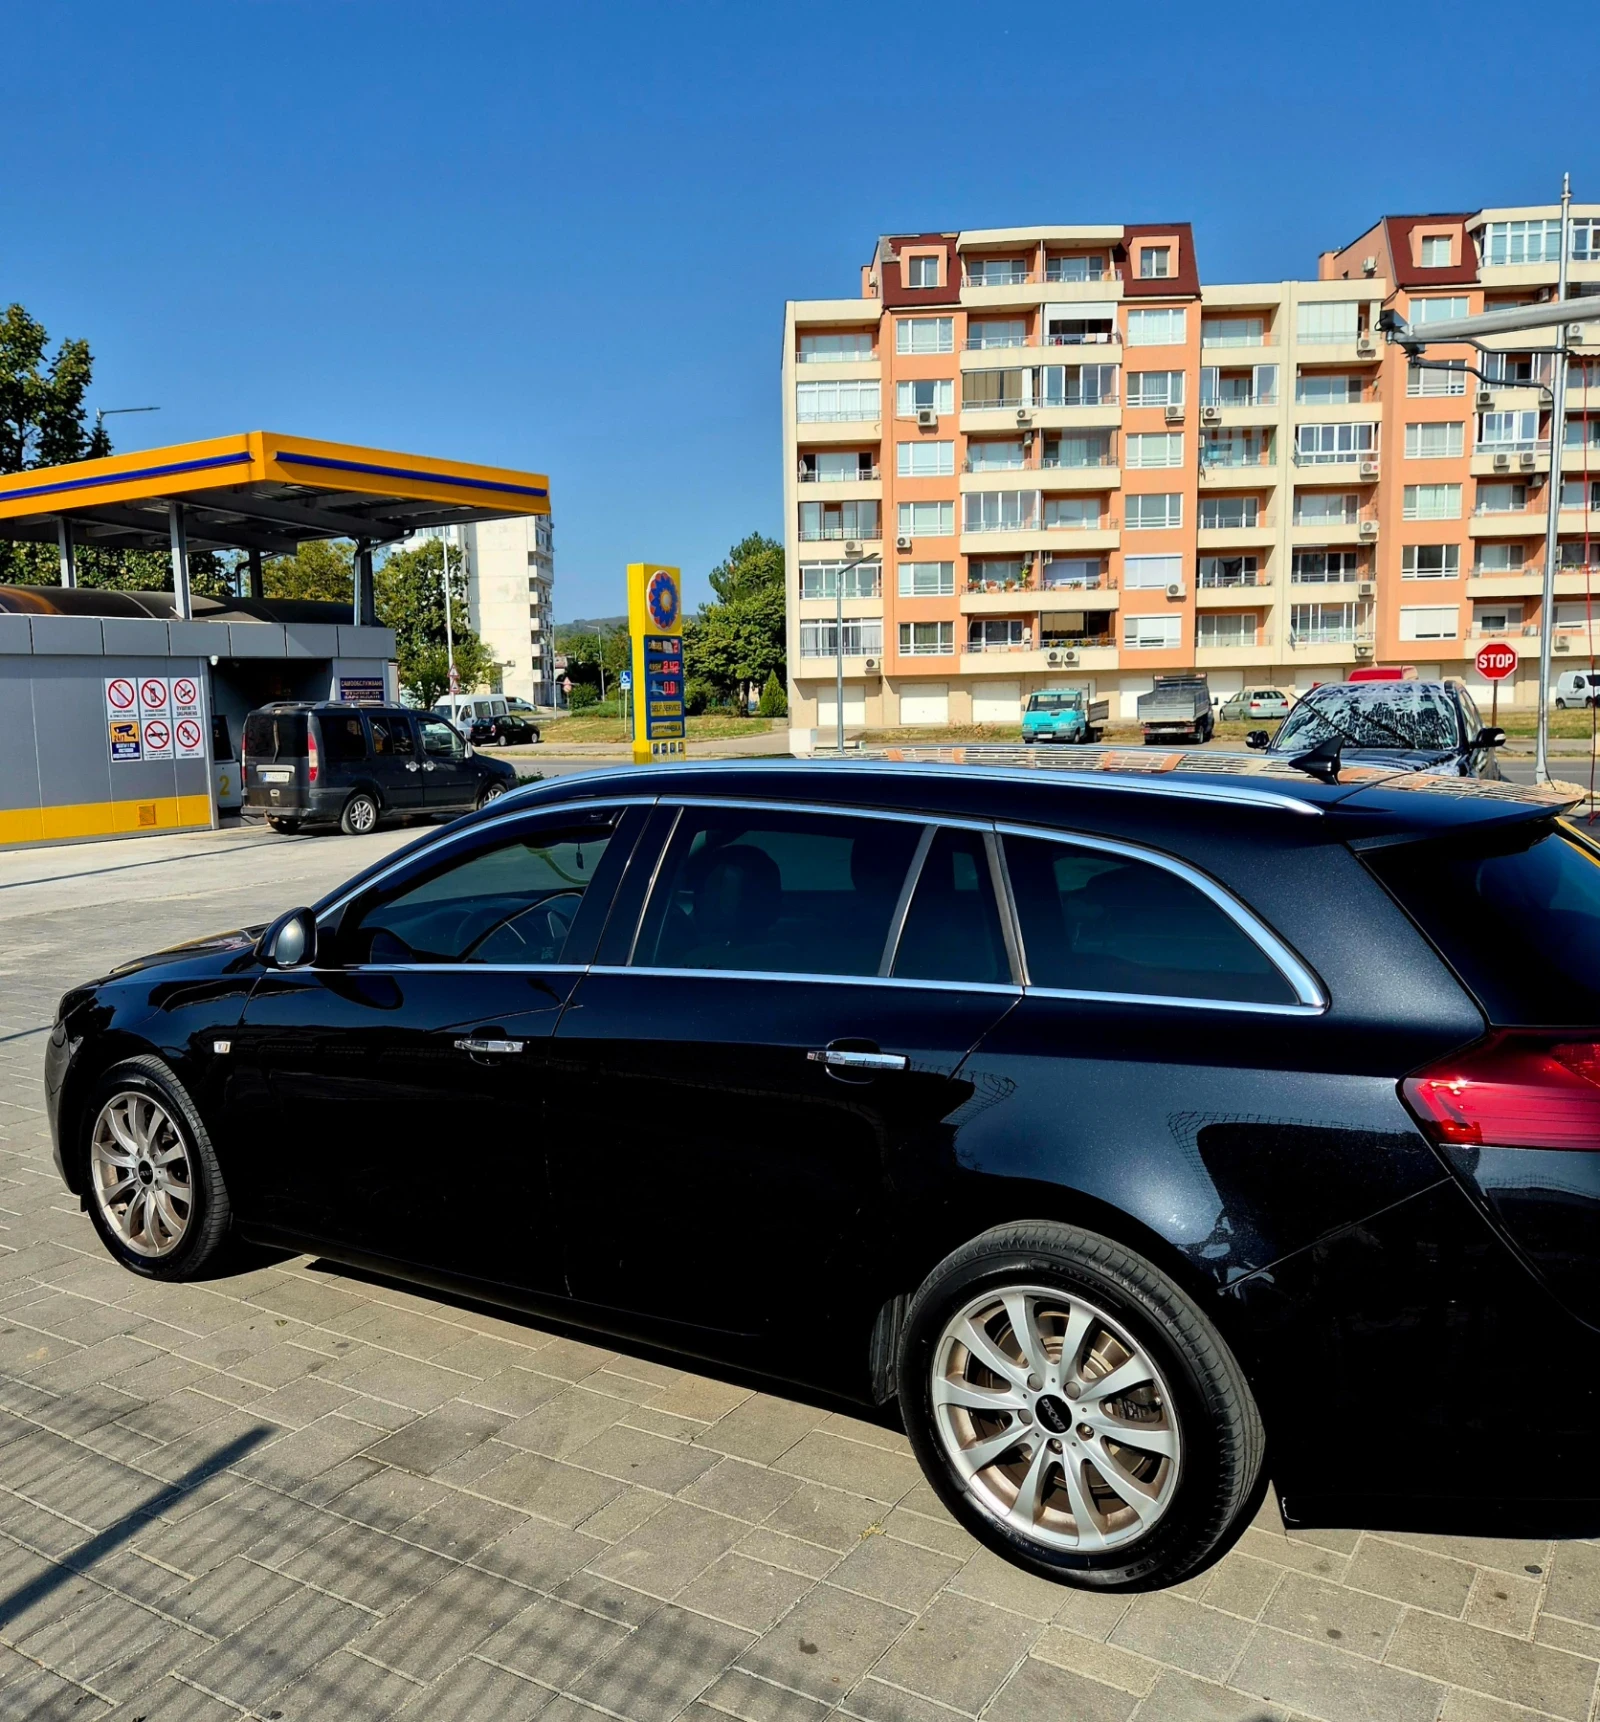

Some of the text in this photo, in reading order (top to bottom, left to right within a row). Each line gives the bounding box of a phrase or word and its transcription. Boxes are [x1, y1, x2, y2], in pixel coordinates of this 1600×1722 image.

[1478, 653, 1513, 669] STOP
[651, 704, 662, 712] SELF
[219, 775, 230, 796] 2
